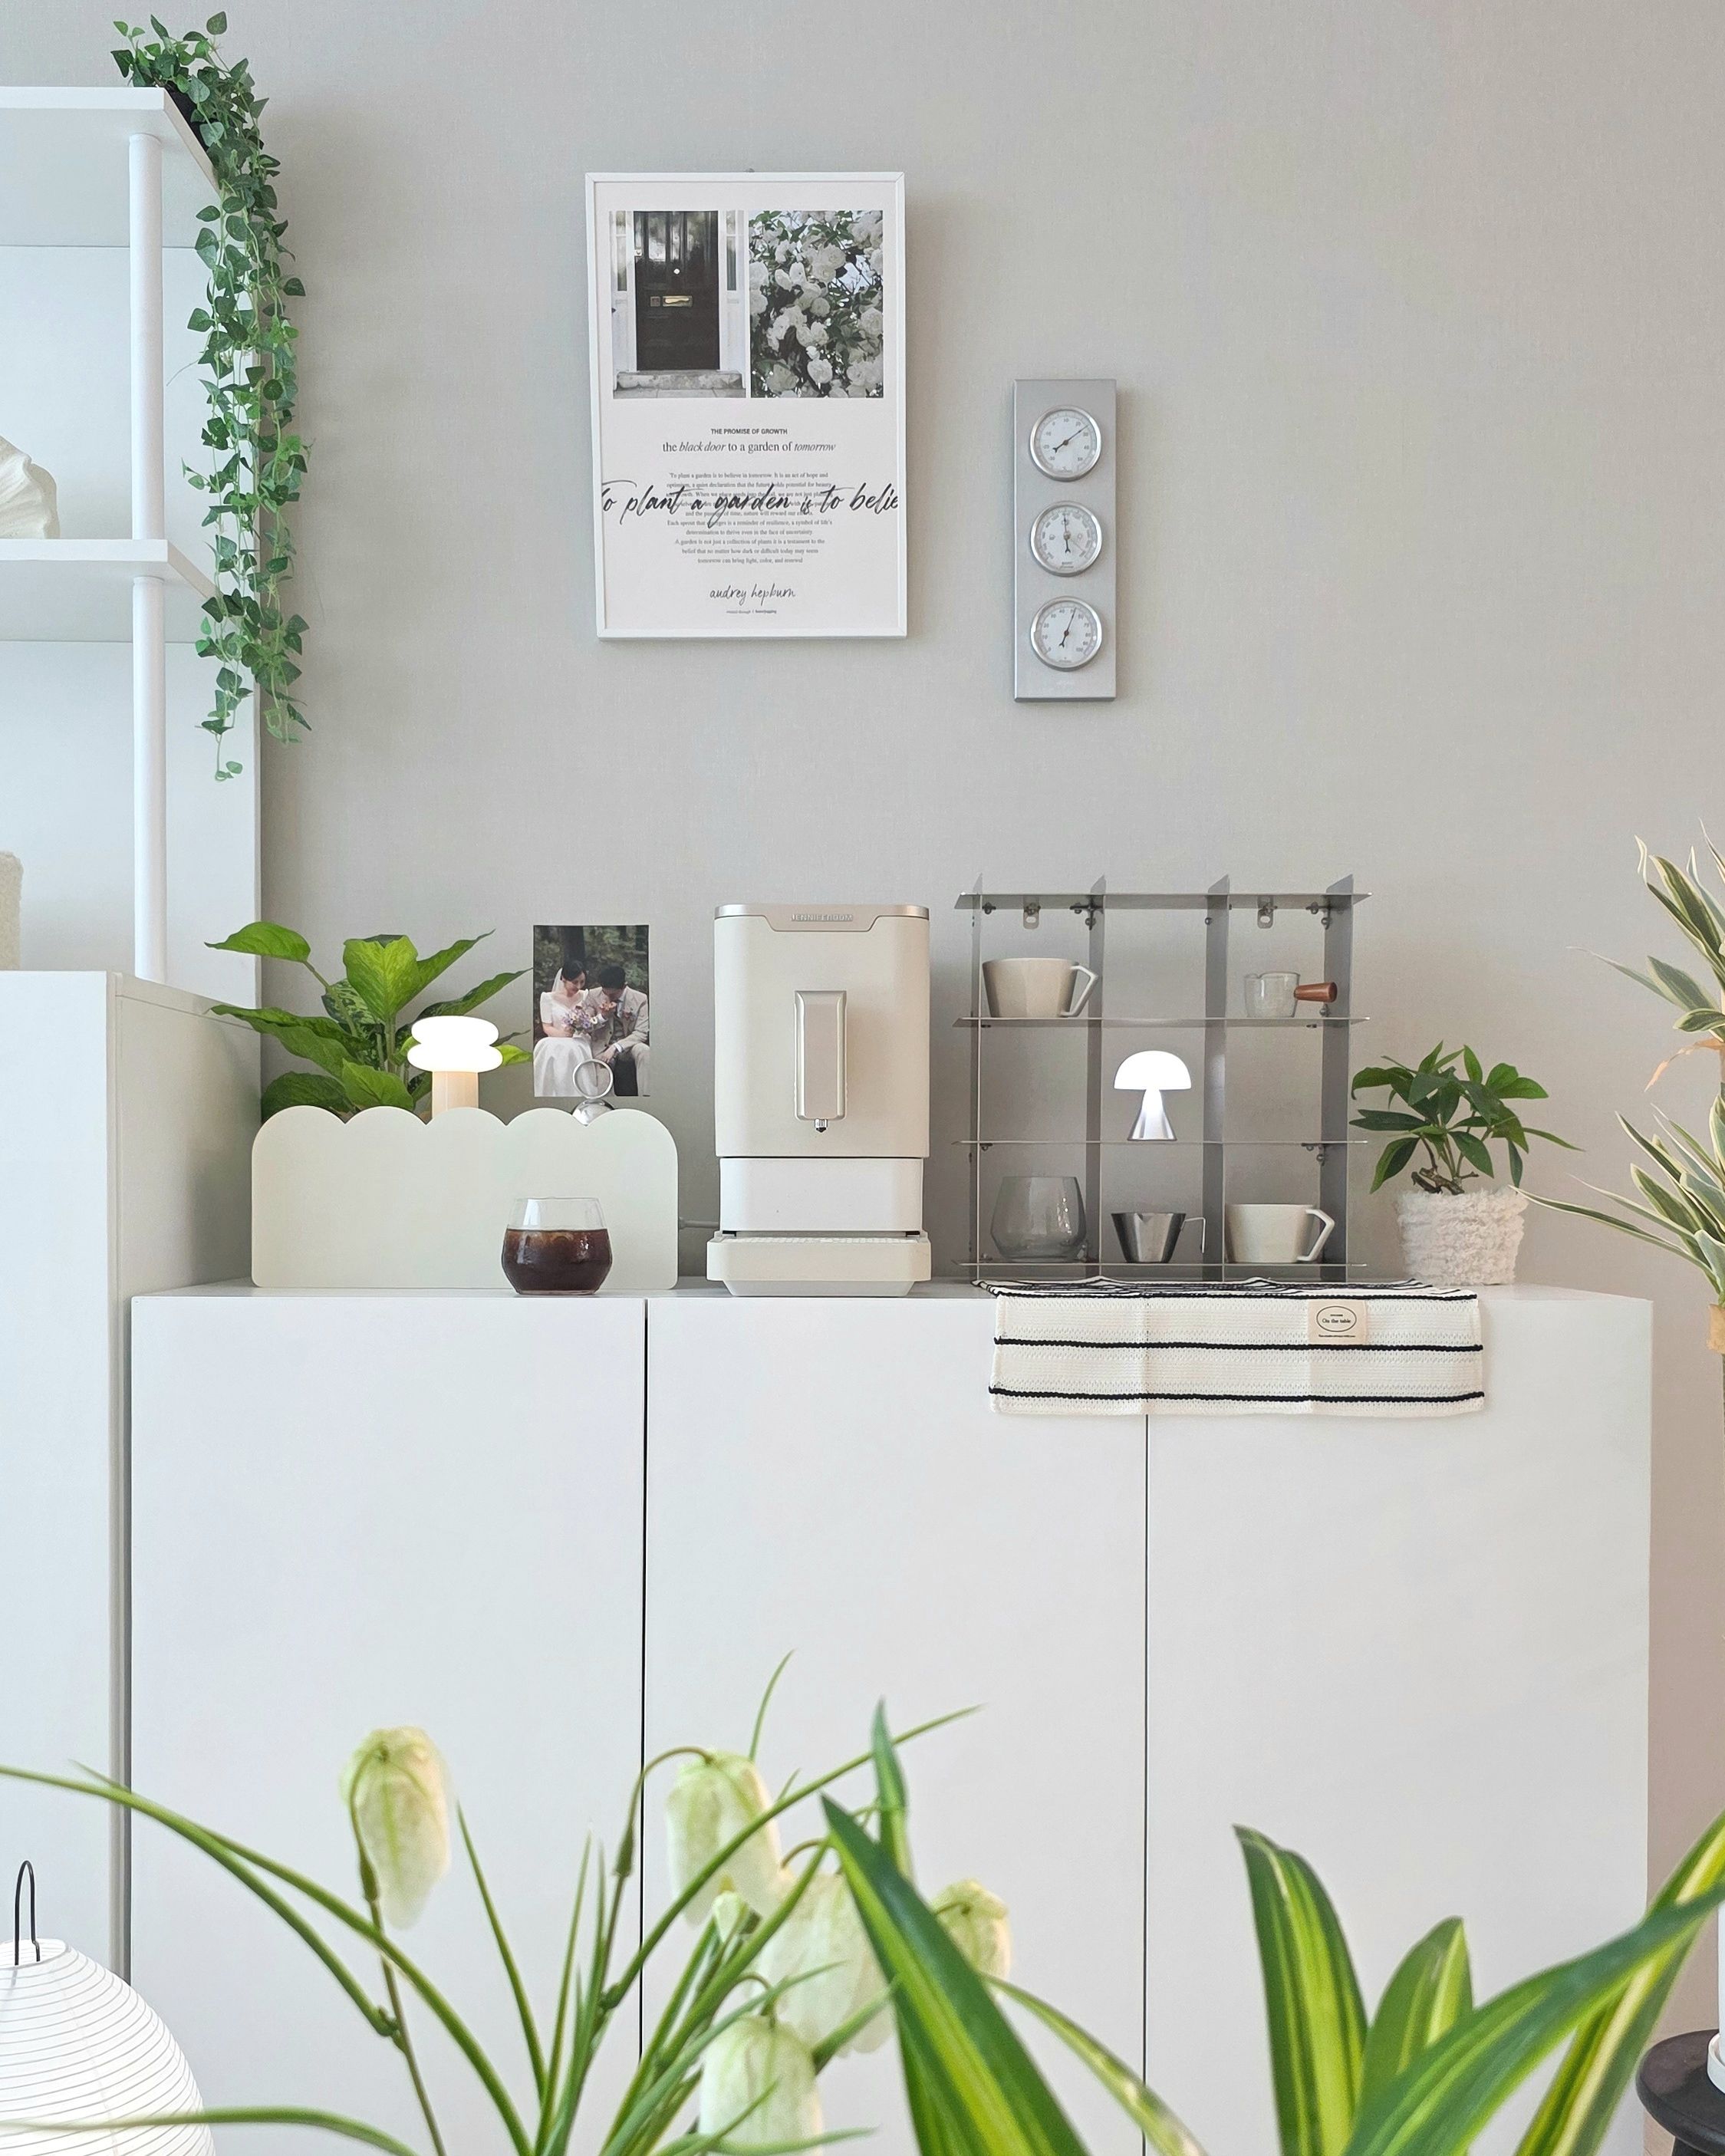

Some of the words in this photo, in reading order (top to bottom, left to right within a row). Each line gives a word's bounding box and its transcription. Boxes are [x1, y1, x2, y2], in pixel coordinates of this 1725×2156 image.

[663, 442, 677, 452] the
[679, 441, 703, 452] black
[704, 441, 726, 452] door
[728, 443, 738, 452] to
[748, 442, 779, 453] garden
[782, 442, 793, 452] of
[794, 443, 836, 452] tomorrow
[620, 485, 704, 525] plant
[690, 498, 707, 510] a
[708, 483, 791, 528] garden
[801, 496, 812, 515] is
[820, 485, 855, 513] to
[709, 584, 747, 606] audrey
[751, 583, 796, 606] hepburn
